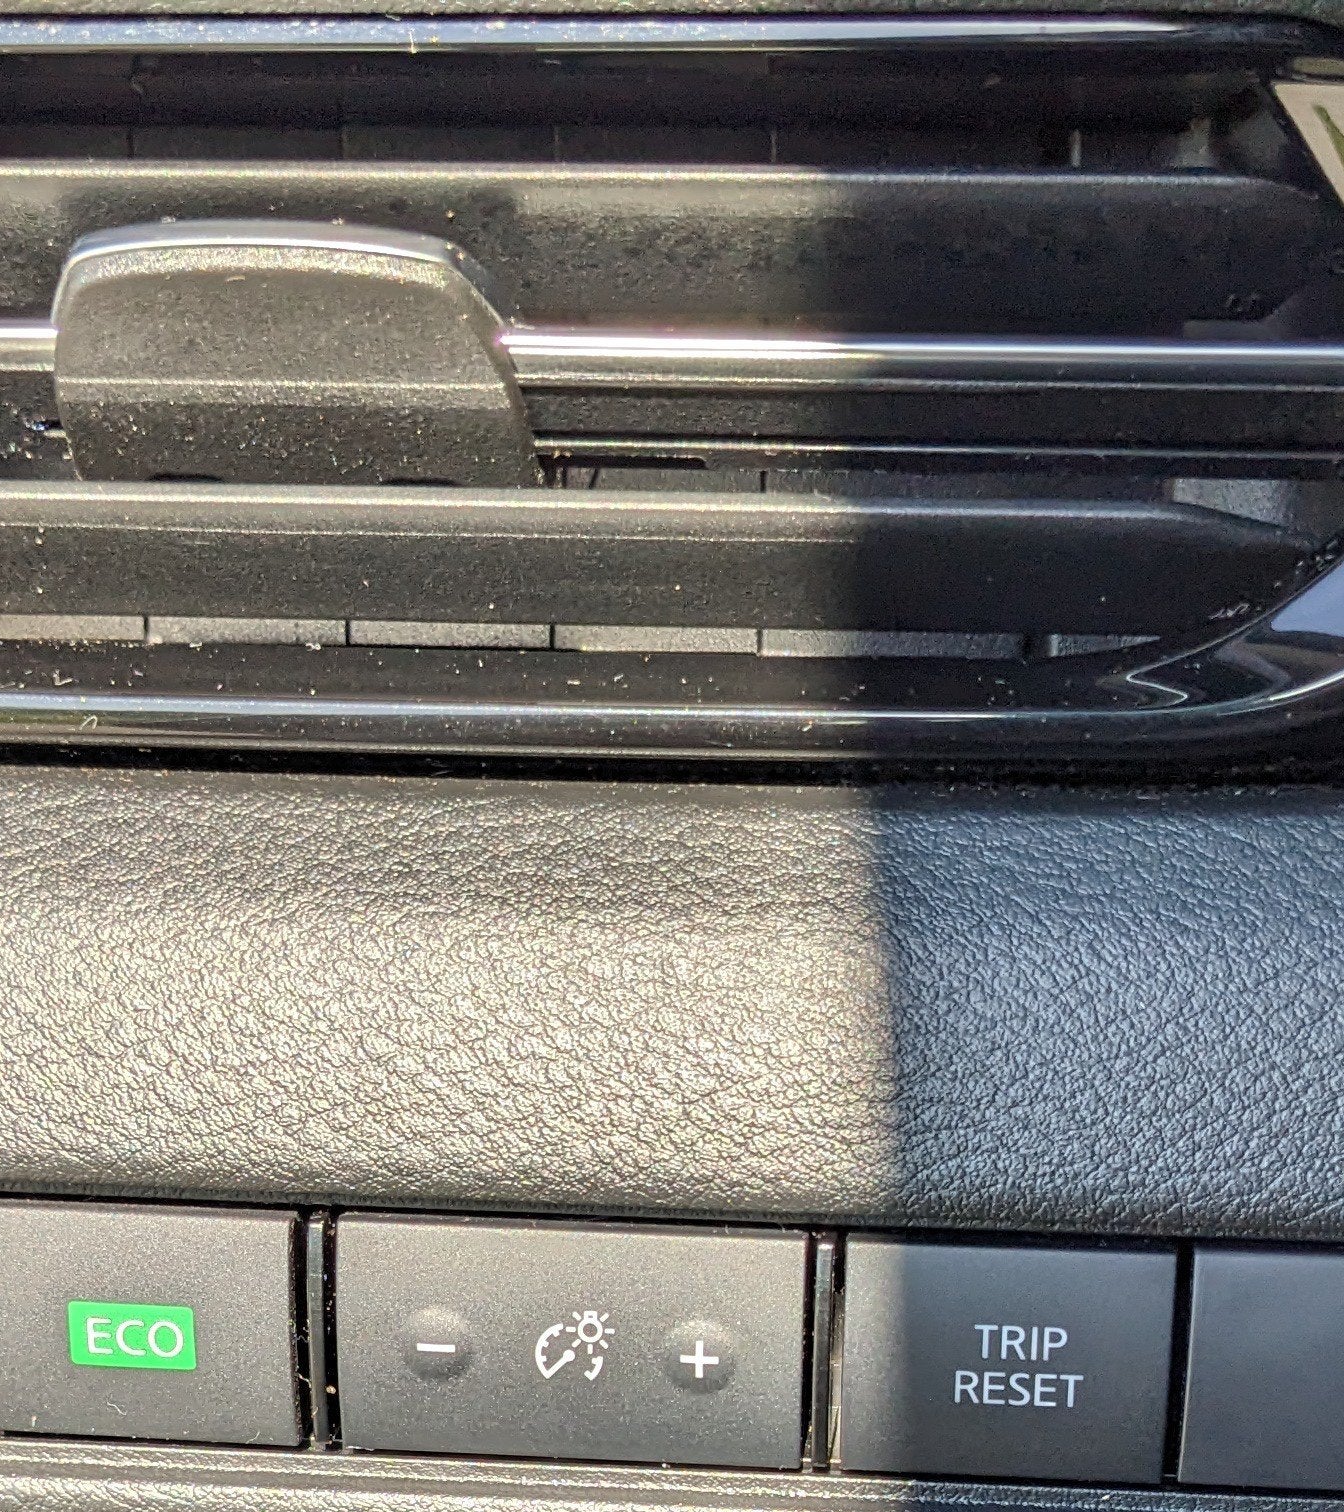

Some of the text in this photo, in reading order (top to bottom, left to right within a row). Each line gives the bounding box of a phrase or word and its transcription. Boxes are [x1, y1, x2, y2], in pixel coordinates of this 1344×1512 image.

[86, 1316, 185, 1359] ECO
[974, 1324, 1068, 1361] TRIP
[954, 1370, 1084, 1408] RESET
